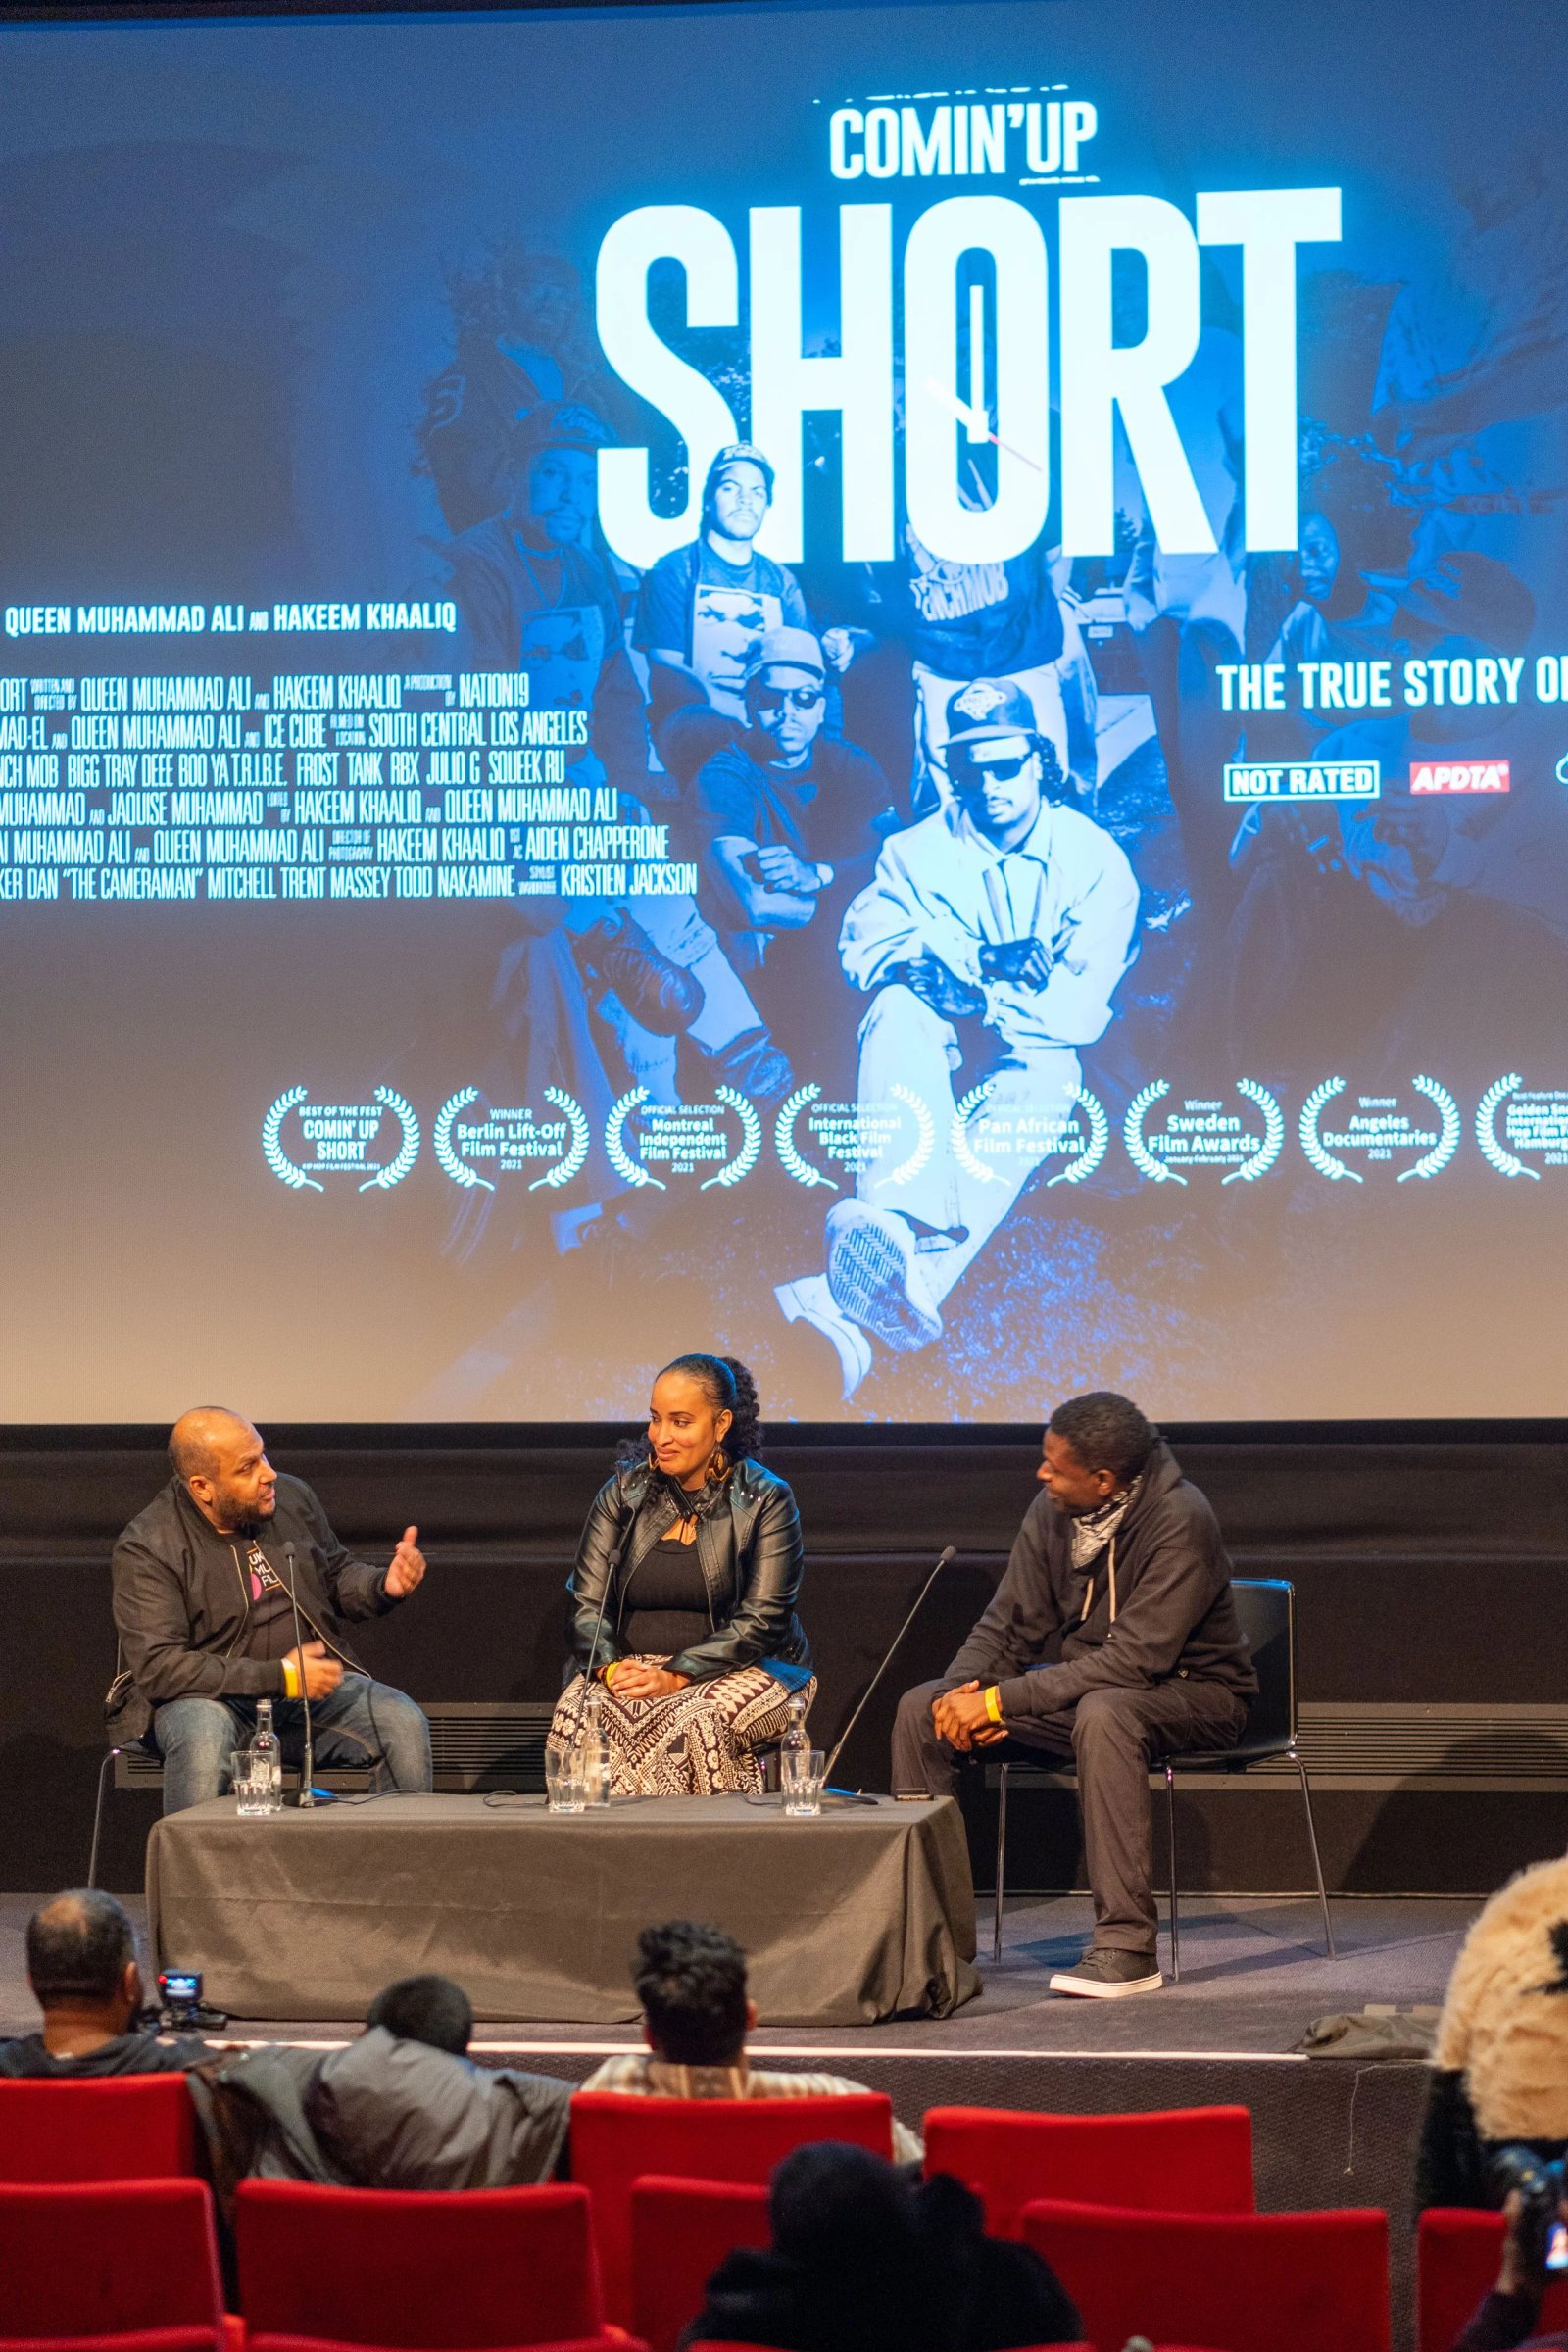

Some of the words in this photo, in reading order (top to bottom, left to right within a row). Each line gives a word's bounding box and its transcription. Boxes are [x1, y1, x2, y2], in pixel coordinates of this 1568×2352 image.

[595, 187, 1342, 570] SHORT
[5, 606, 71, 637] QUEEN
[77, 605, 205, 634] MUHAMMAD
[211, 604, 244, 633] ALI
[249, 611, 269, 631] AND
[274, 604, 360, 632] HAKEEM
[367, 602, 457, 633] KHAALIQ
[1215, 663, 1286, 710] THE
[1297, 662, 1392, 709] TRUE
[1404, 657, 1524, 707] STORY
[81, 677, 128, 712] QUEEN
[132, 676, 224, 711] MUHAMMAD
[227, 676, 252, 710] ALI
[255, 693, 270, 710] AND
[273, 675, 334, 710] HAKEEM
[338, 674, 402, 710] KHAALIQ
[459, 673, 530, 708] NATION19
[51, 733, 68, 750] AND
[71, 715, 119, 751] QUEEN
[122, 714, 214, 750] MUHAMMAD
[217, 714, 241, 750] ALI
[244, 731, 261, 749] AND
[264, 713, 285, 749] ICE
[289, 713, 327, 748] CUBE
[368, 712, 417, 748] SOUTH
[421, 711, 487, 747] CENTRAL
[491, 710, 518, 746] LOS
[521, 710, 588, 746] ANGELES
[26, 754, 59, 789] MOB
[68, 753, 100, 788] BIGG
[103, 753, 138, 788] TRAY
[141, 753, 174, 788] DEEE
[178, 753, 208, 788] BOO
[211, 753, 229, 787] YA
[231, 752, 288, 787] T.R.I.B.E.
[296, 752, 340, 787] FROST
[346, 751, 383, 786] TANK
[390, 751, 420, 786] RBX
[426, 751, 466, 786] JULIO
[469, 751, 480, 785] G
[488, 750, 543, 785] SQUEEK
[545, 749, 565, 784] RU
[1232, 769, 1283, 795] NOT
[1289, 767, 1373, 794] RATED
[89, 809, 105, 826] AND
[107, 791, 168, 826] JAQUISE
[172, 791, 264, 826] MUHAMMAD
[295, 790, 355, 825] HAKEEM
[359, 789, 422, 824] KHAALIQ
[425, 807, 442, 823] AND
[445, 789, 493, 824] QUEEN
[497, 788, 590, 823] MUHAMMAD
[593, 787, 618, 822] ALI
[13, 830, 104, 864] MUHAMMAD
[108, 830, 131, 864] ALI
[134, 847, 150, 864] AND
[153, 829, 202, 864] QUEEN
[206, 829, 297, 864] MUHAMMAD
[301, 829, 325, 863] ALI
[377, 827, 438, 862] HAKEEM
[442, 827, 506, 862] KHAALIQ
[525, 825, 569, 861] AIDEN
[573, 825, 670, 860] CHAPPERONE
[26, 867, 59, 900] DAN
[207, 866, 277, 900] MITCHELL
[280, 866, 327, 899] TRENT
[330, 865, 392, 899] MASSEY
[394, 865, 433, 899] TODD
[437, 864, 515, 899] NAKAMINE
[561, 863, 626, 896] KRISTIEN
[629, 862, 698, 896] JACKSON
[299, 1105, 323, 1117] BEST
[323, 1105, 338, 1117] OF
[338, 1105, 359, 1117] THE
[359, 1105, 383, 1117] FEST
[640, 1104, 677, 1116] OFFICIAL
[678, 1104, 725, 1115] SELECTION
[811, 1102, 851, 1114] OFFICIAL
[1184, 1099, 1223, 1112] Winner
[1358, 1096, 1397, 1109] Winner
[1507, 1103, 1550, 1116] Golden
[490, 1108, 533, 1121] WINNER
[1166, 1112, 1241, 1133] Sweden
[303, 1119, 357, 1140] COMIN'
[359, 1119, 379, 1140] UP
[457, 1123, 504, 1140] Berlin
[508, 1122, 566, 1140] Lift-Off
[652, 1117, 714, 1132] Montreal
[808, 1116, 902, 1131] International
[979, 1118, 1012, 1134] Pan
[1016, 1116, 1080, 1134] African
[1349, 1114, 1410, 1133] Angeles
[639, 1132, 727, 1149] Independent
[819, 1130, 858, 1146] Black
[860, 1131, 892, 1145] Film
[1324, 1129, 1438, 1147] Documentaries
[1506, 1126, 1532, 1139] Hop
[1533, 1126, 1559, 1138] Film
[317, 1140, 367, 1161] SHORT
[461, 1141, 496, 1157] Film
[500, 1140, 563, 1157] Festival
[974, 1137, 1011, 1153] Film
[1016, 1135, 1086, 1154] Festival
[1148, 1134, 1189, 1153] Film
[1191, 1133, 1261, 1153] Awards
[640, 1145, 670, 1160] Film
[672, 1145, 727, 1160] Festival
[828, 1145, 883, 1159] Festival
[1367, 1148, 1392, 1160] 2021
[1544, 1152, 1568, 1165] 2021
[500, 1158, 522, 1170] 2021
[671, 1162, 694, 1173] 2021
[844, 1161, 867, 1173] 2021
